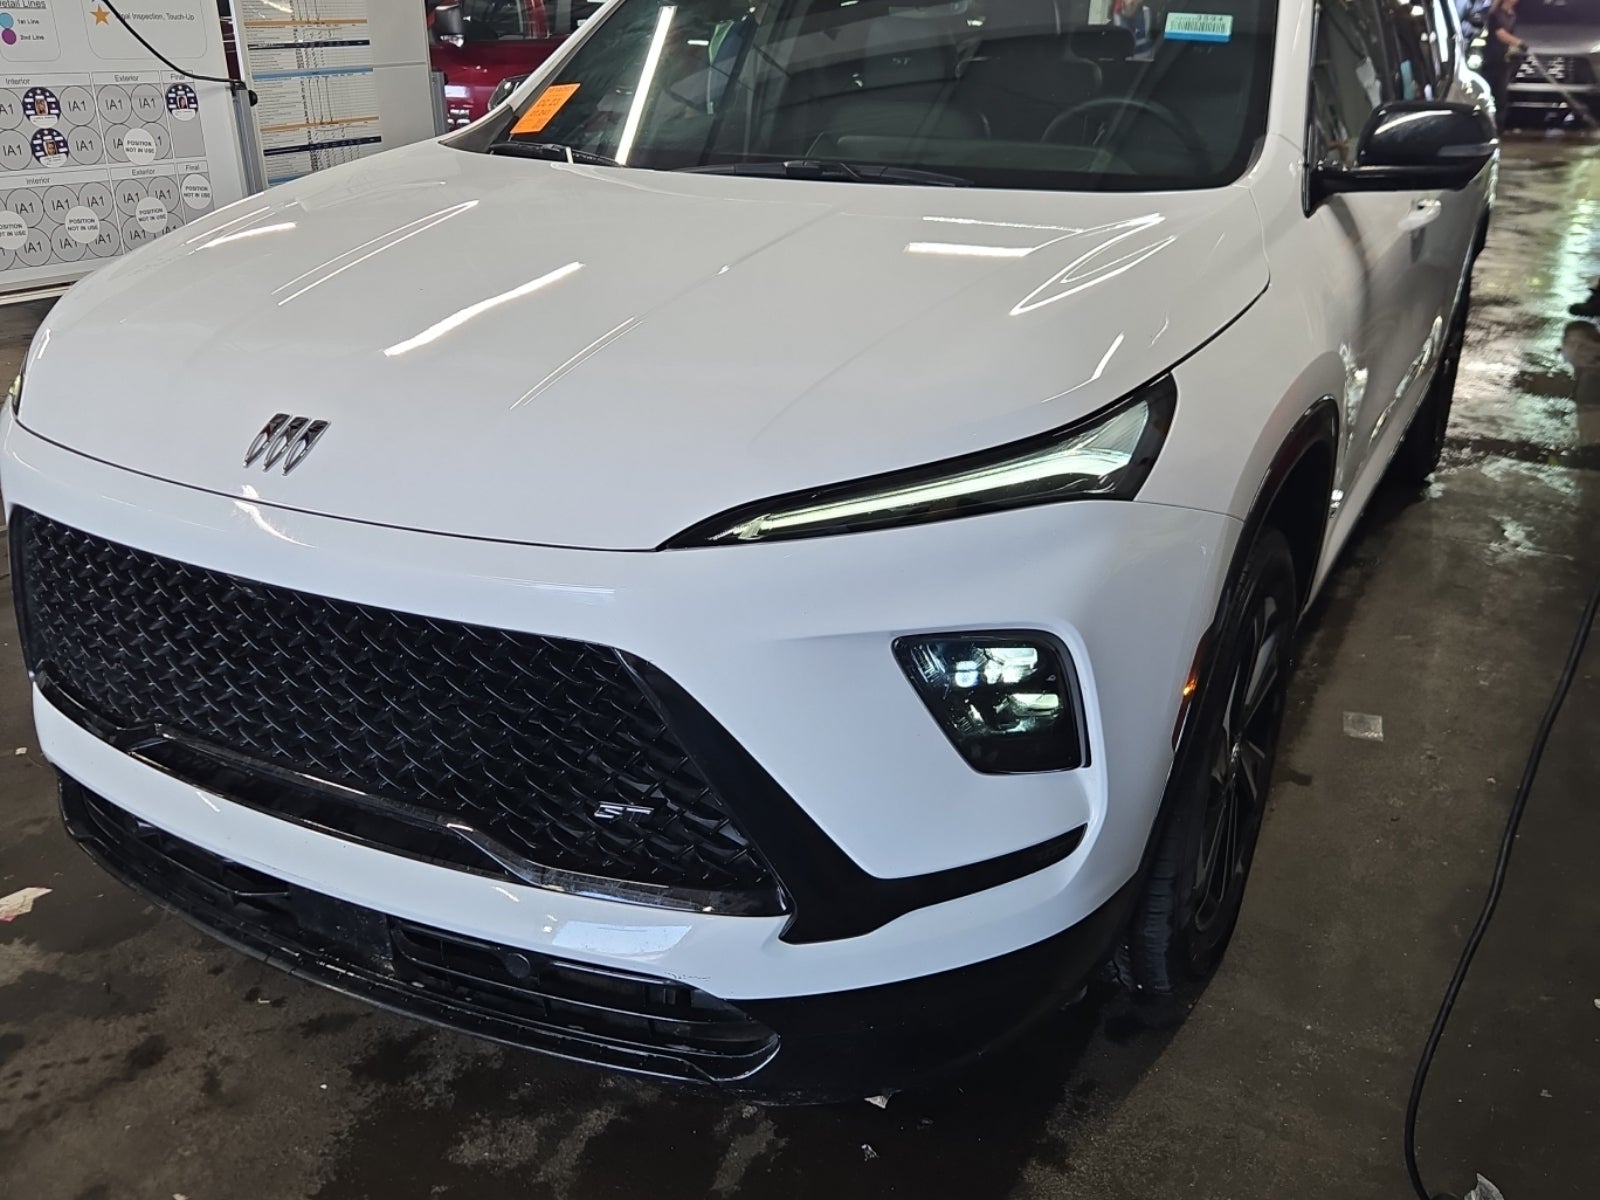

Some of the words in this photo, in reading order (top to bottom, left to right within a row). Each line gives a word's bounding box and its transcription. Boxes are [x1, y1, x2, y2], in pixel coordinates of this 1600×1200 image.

[5, 77, 30, 85] Interior
[112, 138, 123, 149] IA
[127, 139, 152, 147] POSITION
[131, 168, 155, 176] Exterior
[26, 176, 50, 184] Interior
[138, 207, 163, 215] POSITION
